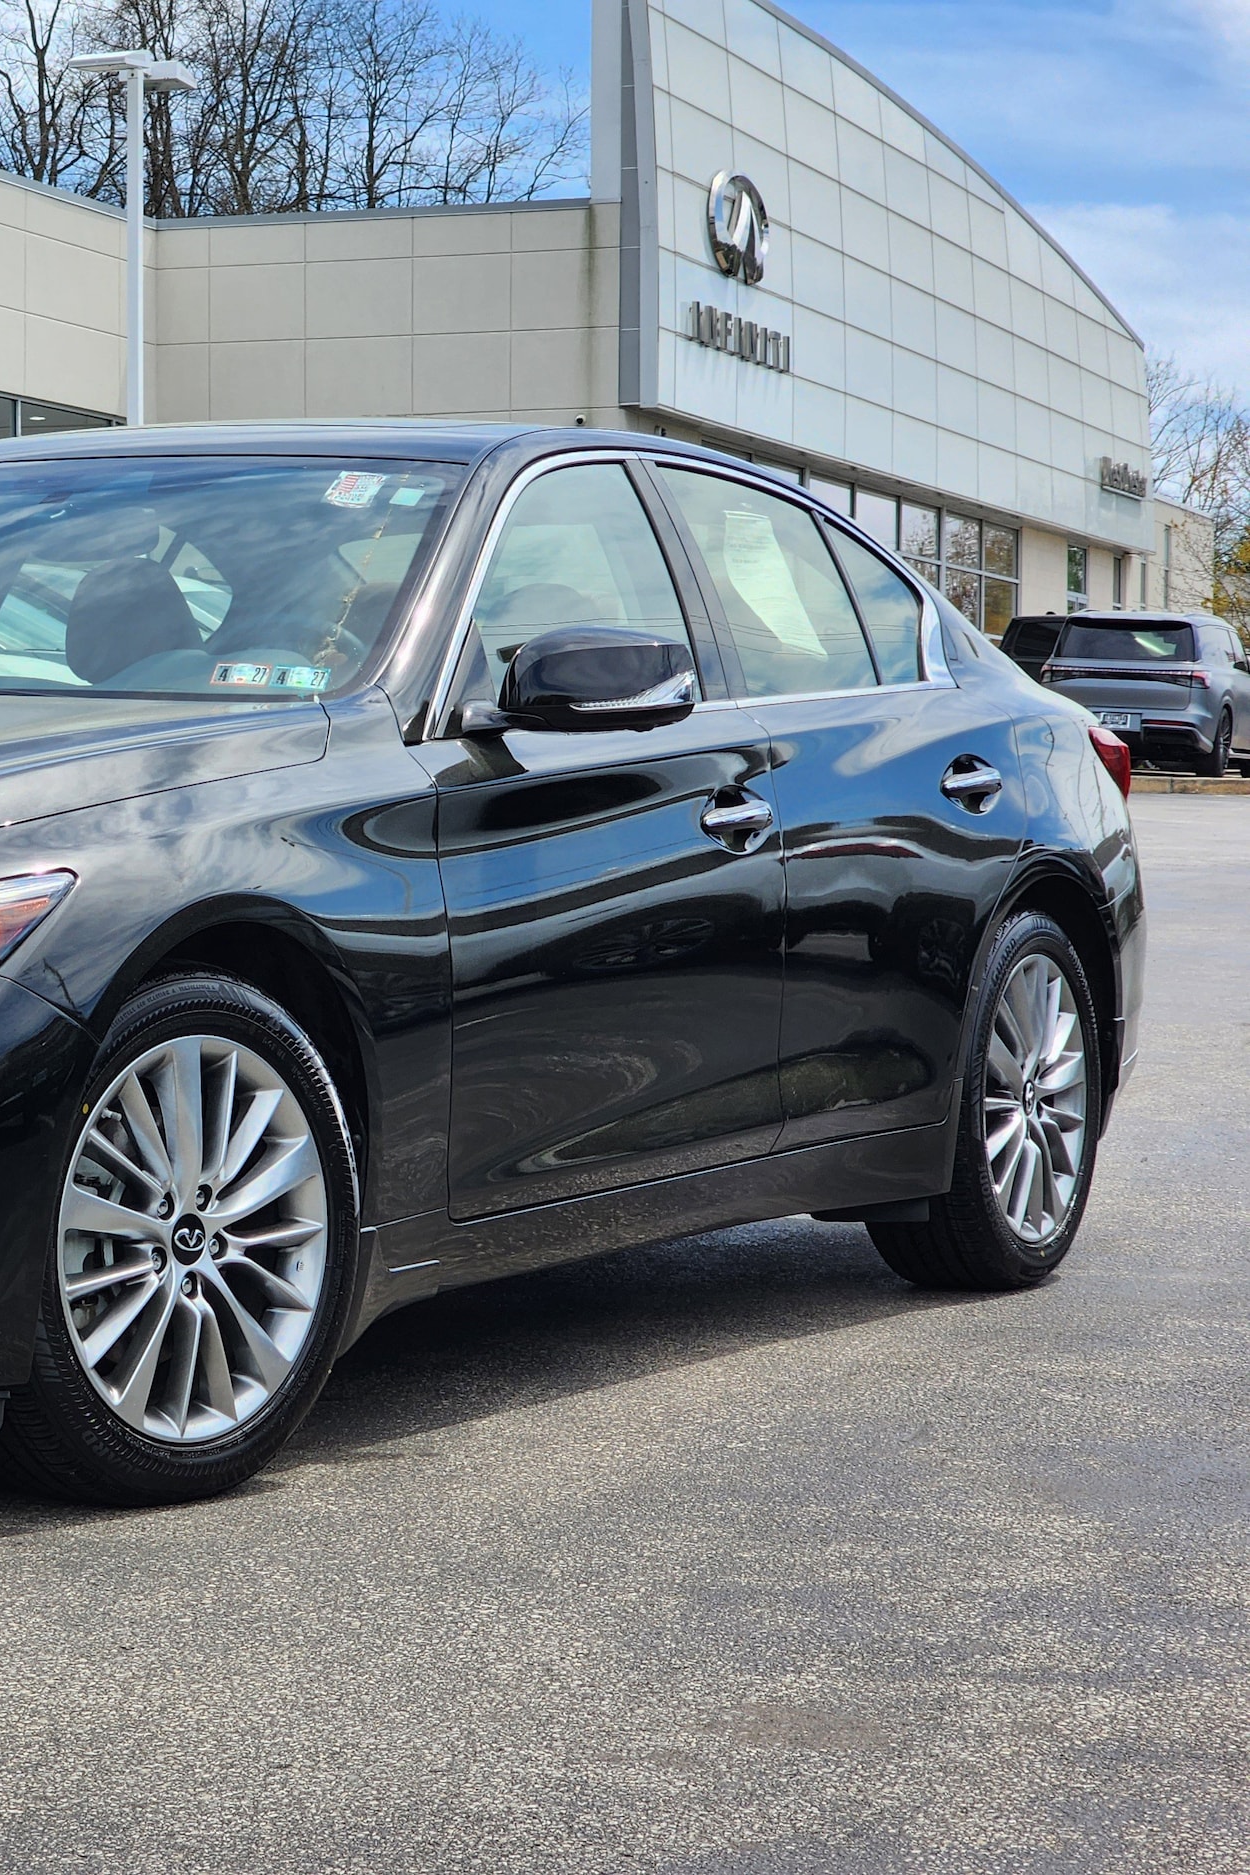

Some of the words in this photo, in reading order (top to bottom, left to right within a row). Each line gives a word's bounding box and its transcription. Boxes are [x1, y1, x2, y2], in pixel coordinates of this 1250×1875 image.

[689, 301, 790, 373] INFINITI
[218, 668, 229, 682] 4
[251, 667, 268, 683] 27
[277, 671, 287, 685] 4
[310, 671, 326, 686] 27
